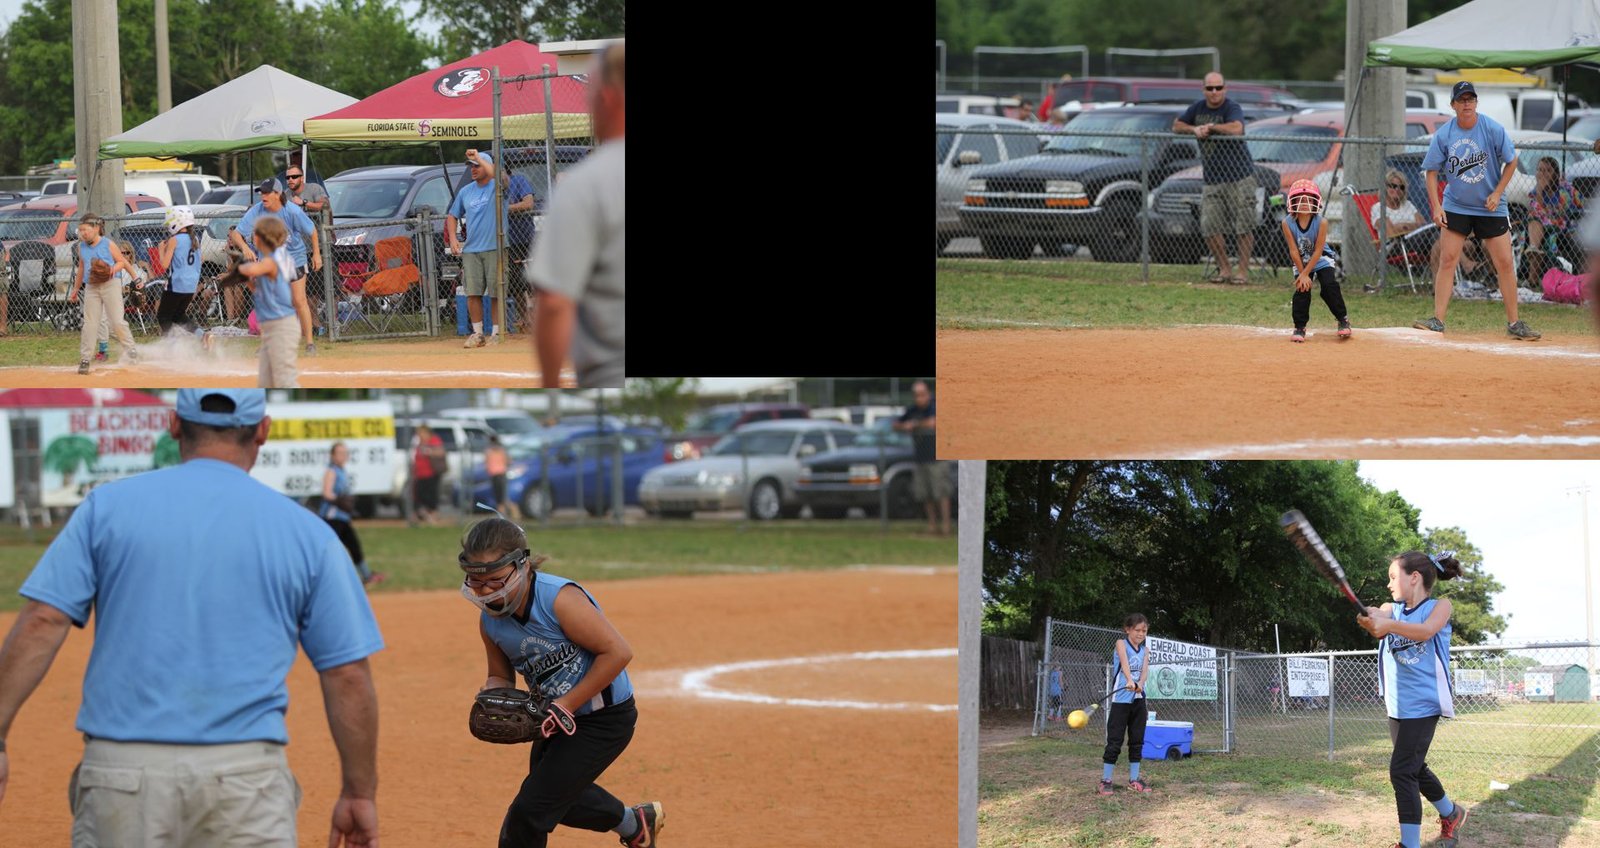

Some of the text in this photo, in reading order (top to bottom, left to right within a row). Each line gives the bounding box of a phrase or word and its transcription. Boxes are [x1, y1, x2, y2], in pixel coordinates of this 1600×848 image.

[367, 122, 415, 132] FLORIDA STATE
[431, 126, 478, 137] SEMINOLES
[1448, 151, 1488, 174] Perdido
[1460, 173, 1485, 183] WAVES
[187, 248, 195, 266] 6
[1150, 639, 1211, 659] EMERALD COAST
[1148, 651, 1173, 664] GRASS
[1289, 659, 1327, 670] BILL FERGUSON
[1185, 668, 1213, 679] GOOD LUCK
[1183, 677, 1217, 687] CHRISTOPHER
